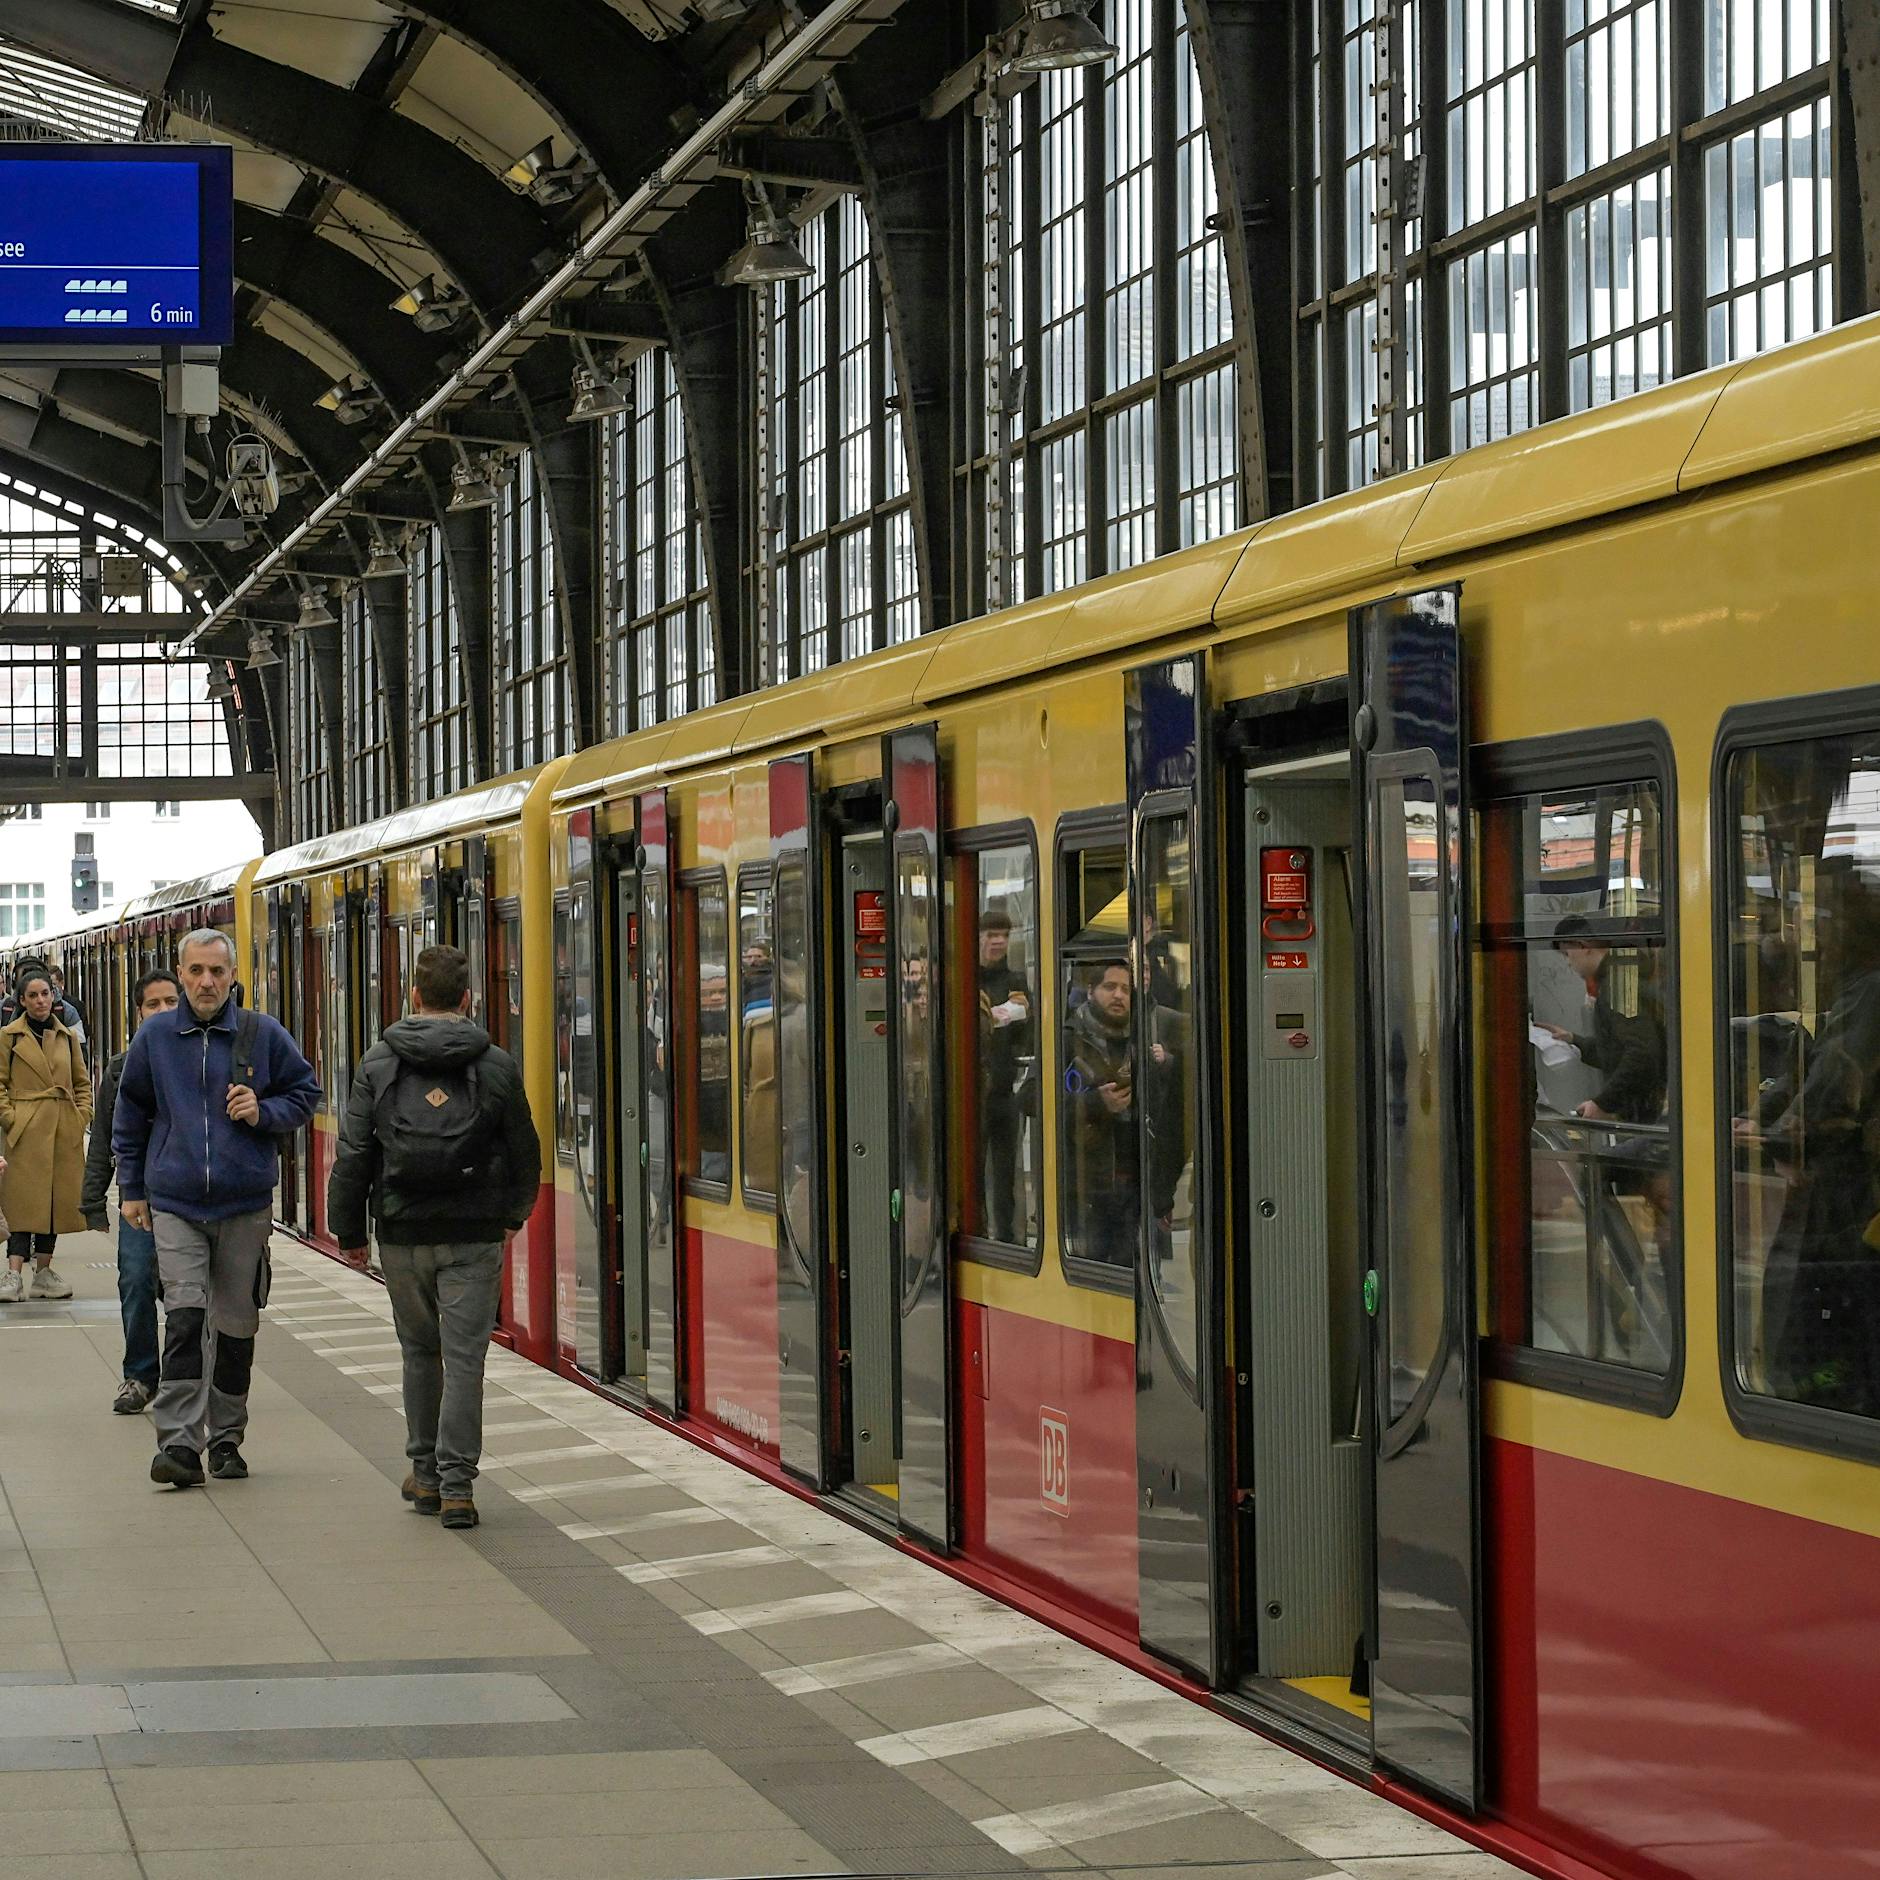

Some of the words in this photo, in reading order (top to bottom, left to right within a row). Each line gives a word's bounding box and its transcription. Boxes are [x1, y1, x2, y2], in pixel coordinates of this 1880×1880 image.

[151, 302, 162, 322] 6
[167, 306, 193, 322] min
[1043, 1422, 1066, 1499] DB
